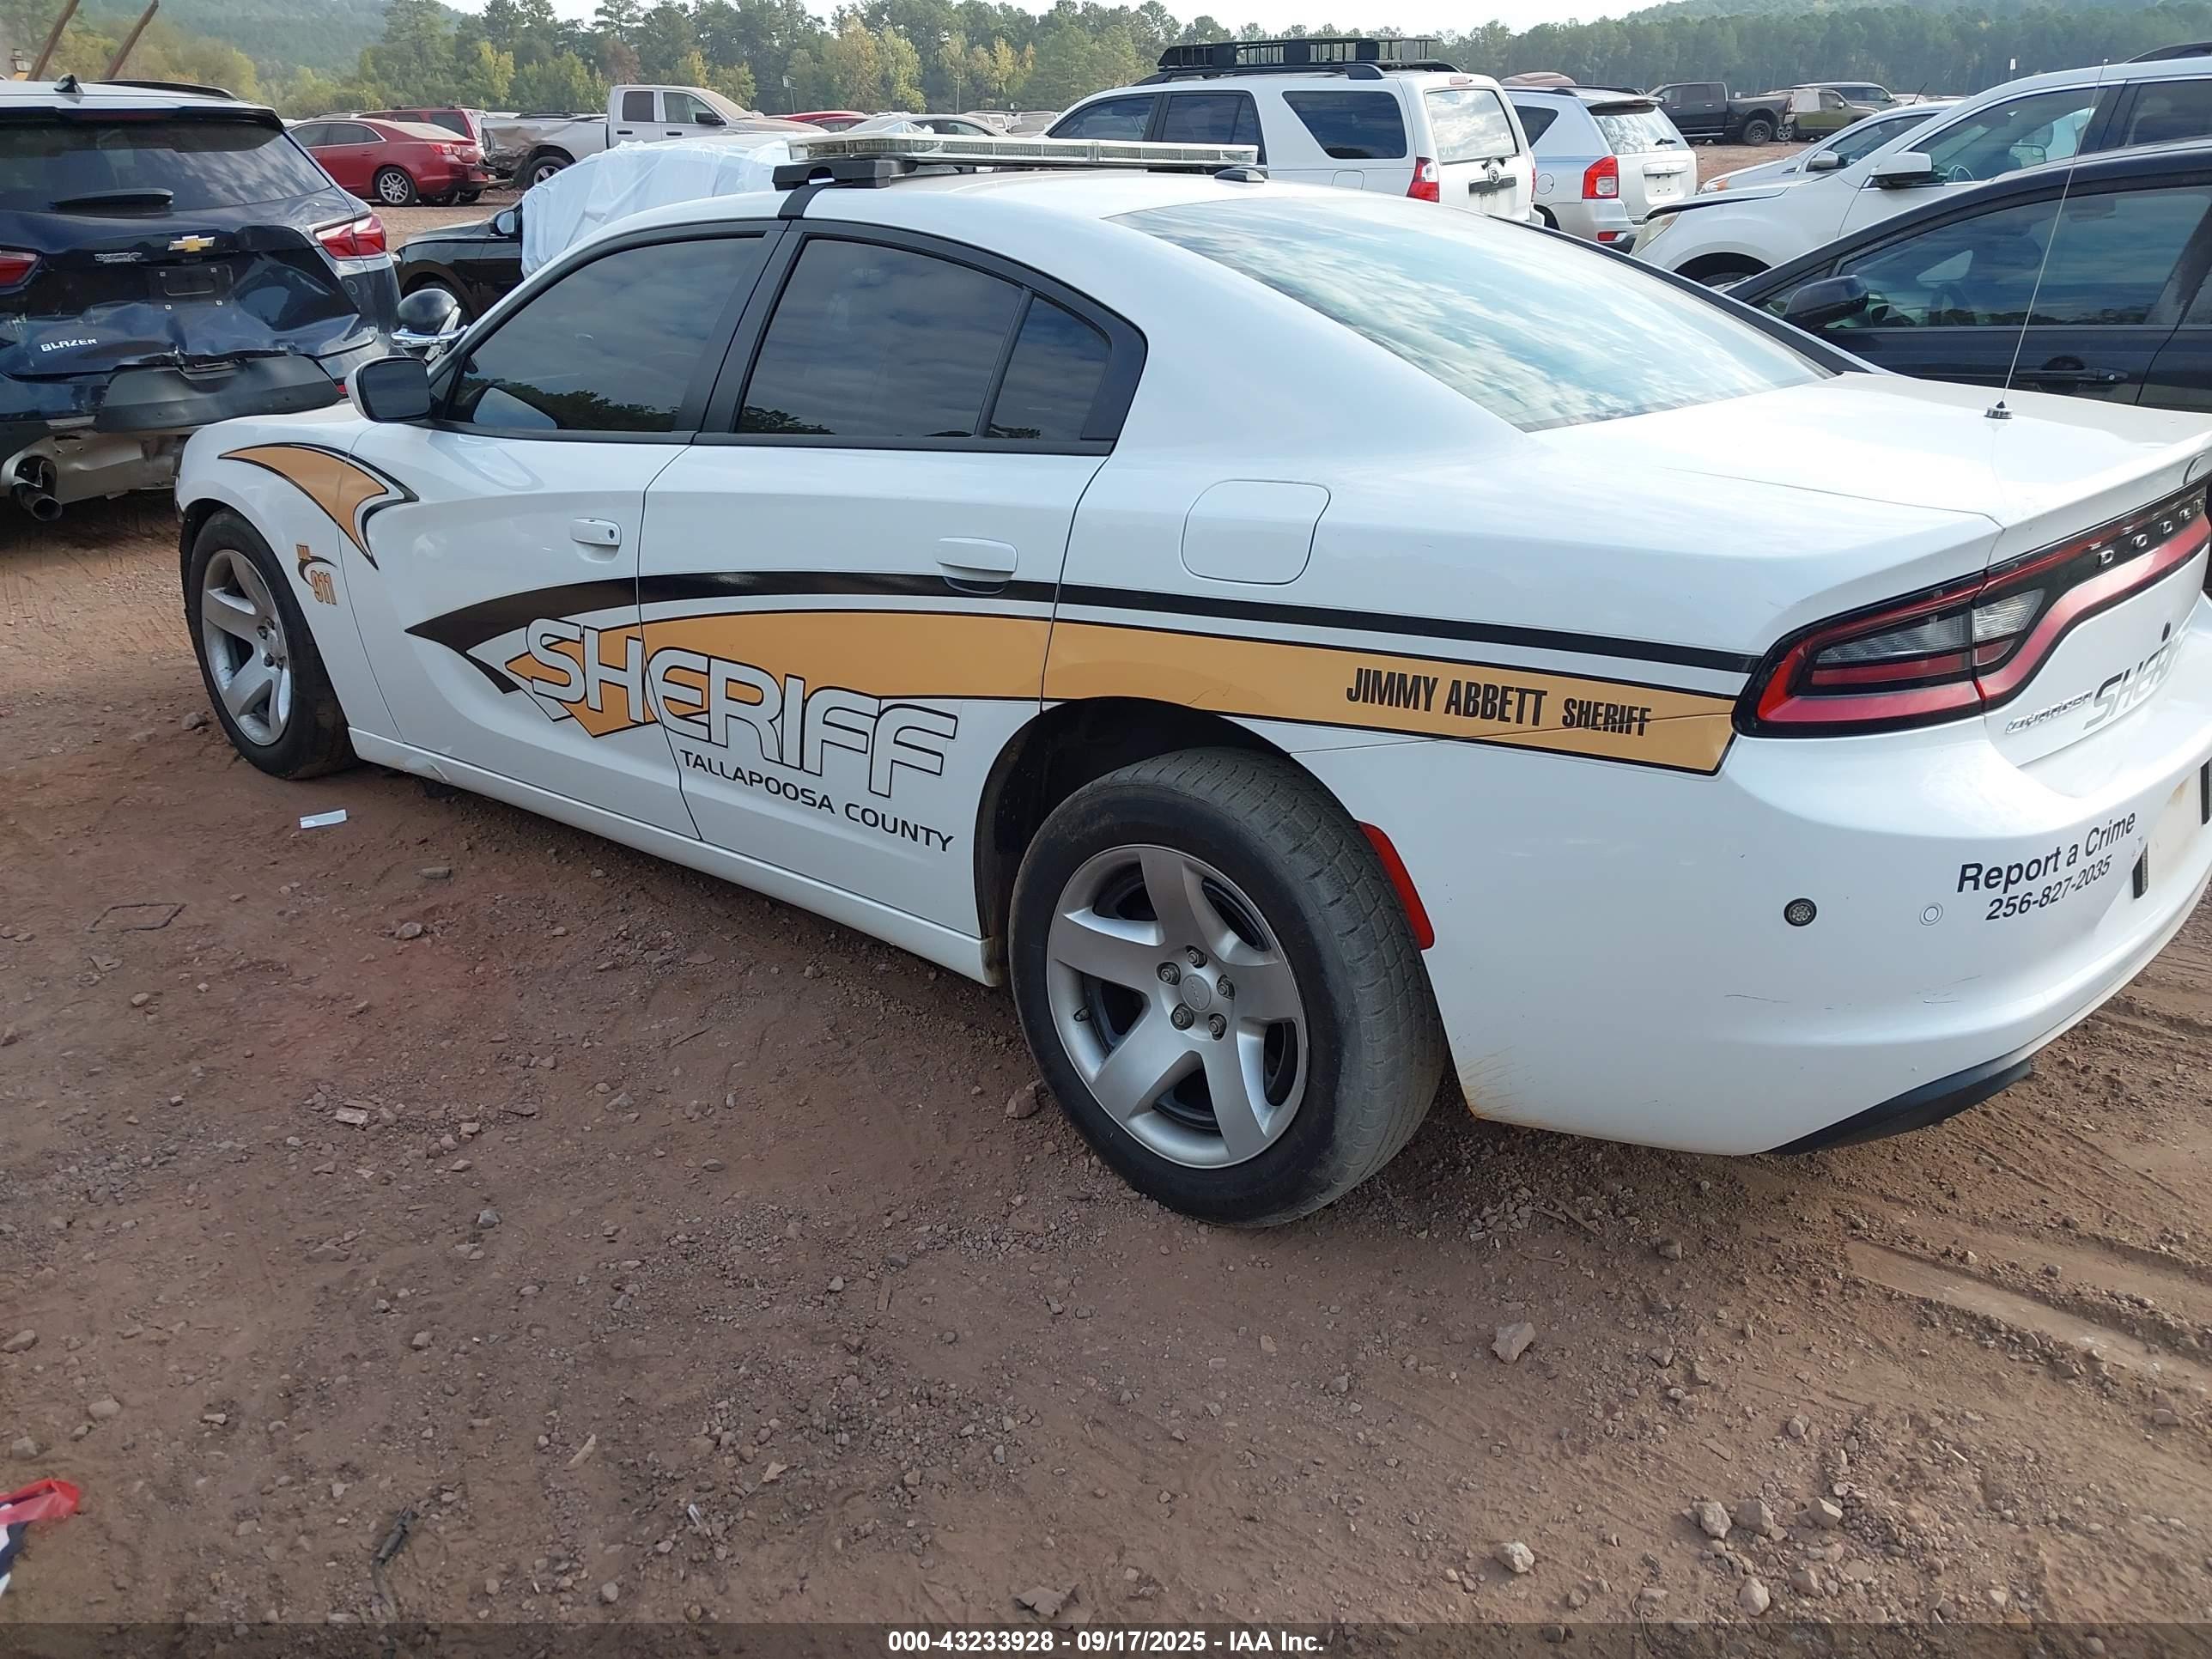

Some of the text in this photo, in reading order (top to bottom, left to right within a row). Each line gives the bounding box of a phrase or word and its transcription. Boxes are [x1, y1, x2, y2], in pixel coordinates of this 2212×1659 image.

[40, 338, 98, 352] BLAZER
[311, 570, 337, 605] 911
[526, 617, 958, 799] SHERIFF
[1346, 667, 1651, 737] JIMMY ABBETT SHERIFF
[679, 749, 954, 853] TALLAPOOSA COUNTY
[1957, 811, 2136, 894] Report a Crime
[1985, 854, 2112, 921] 256-827-2035
